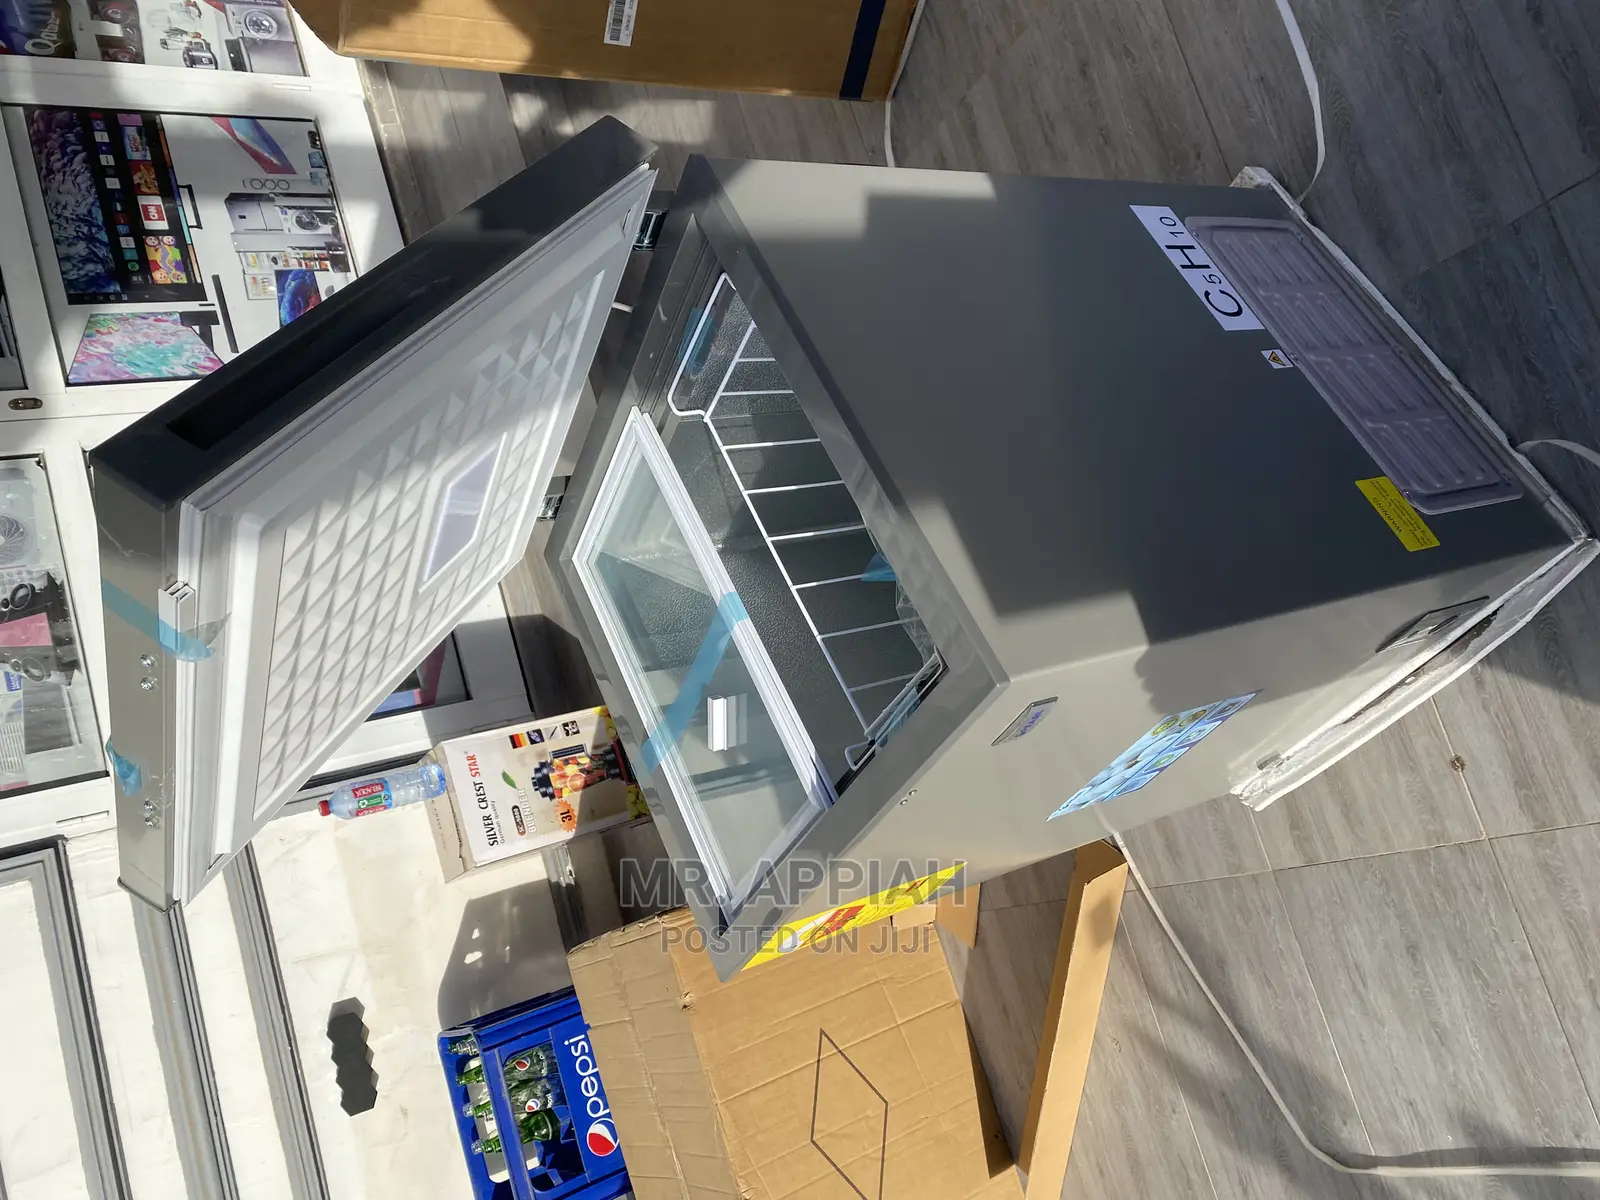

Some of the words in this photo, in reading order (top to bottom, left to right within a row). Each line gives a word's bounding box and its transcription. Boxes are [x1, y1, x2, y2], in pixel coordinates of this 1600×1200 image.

[1372, 497, 1403, 533] WARNING
[466, 754, 481, 778] STAR
[473, 781, 489, 810] CREST
[517, 788, 537, 833] BLENDER
[482, 814, 499, 846] SILVER
[560, 809, 572, 823] 3L
[495, 821, 505, 844] German
[564, 1034, 610, 1118] pepsi
